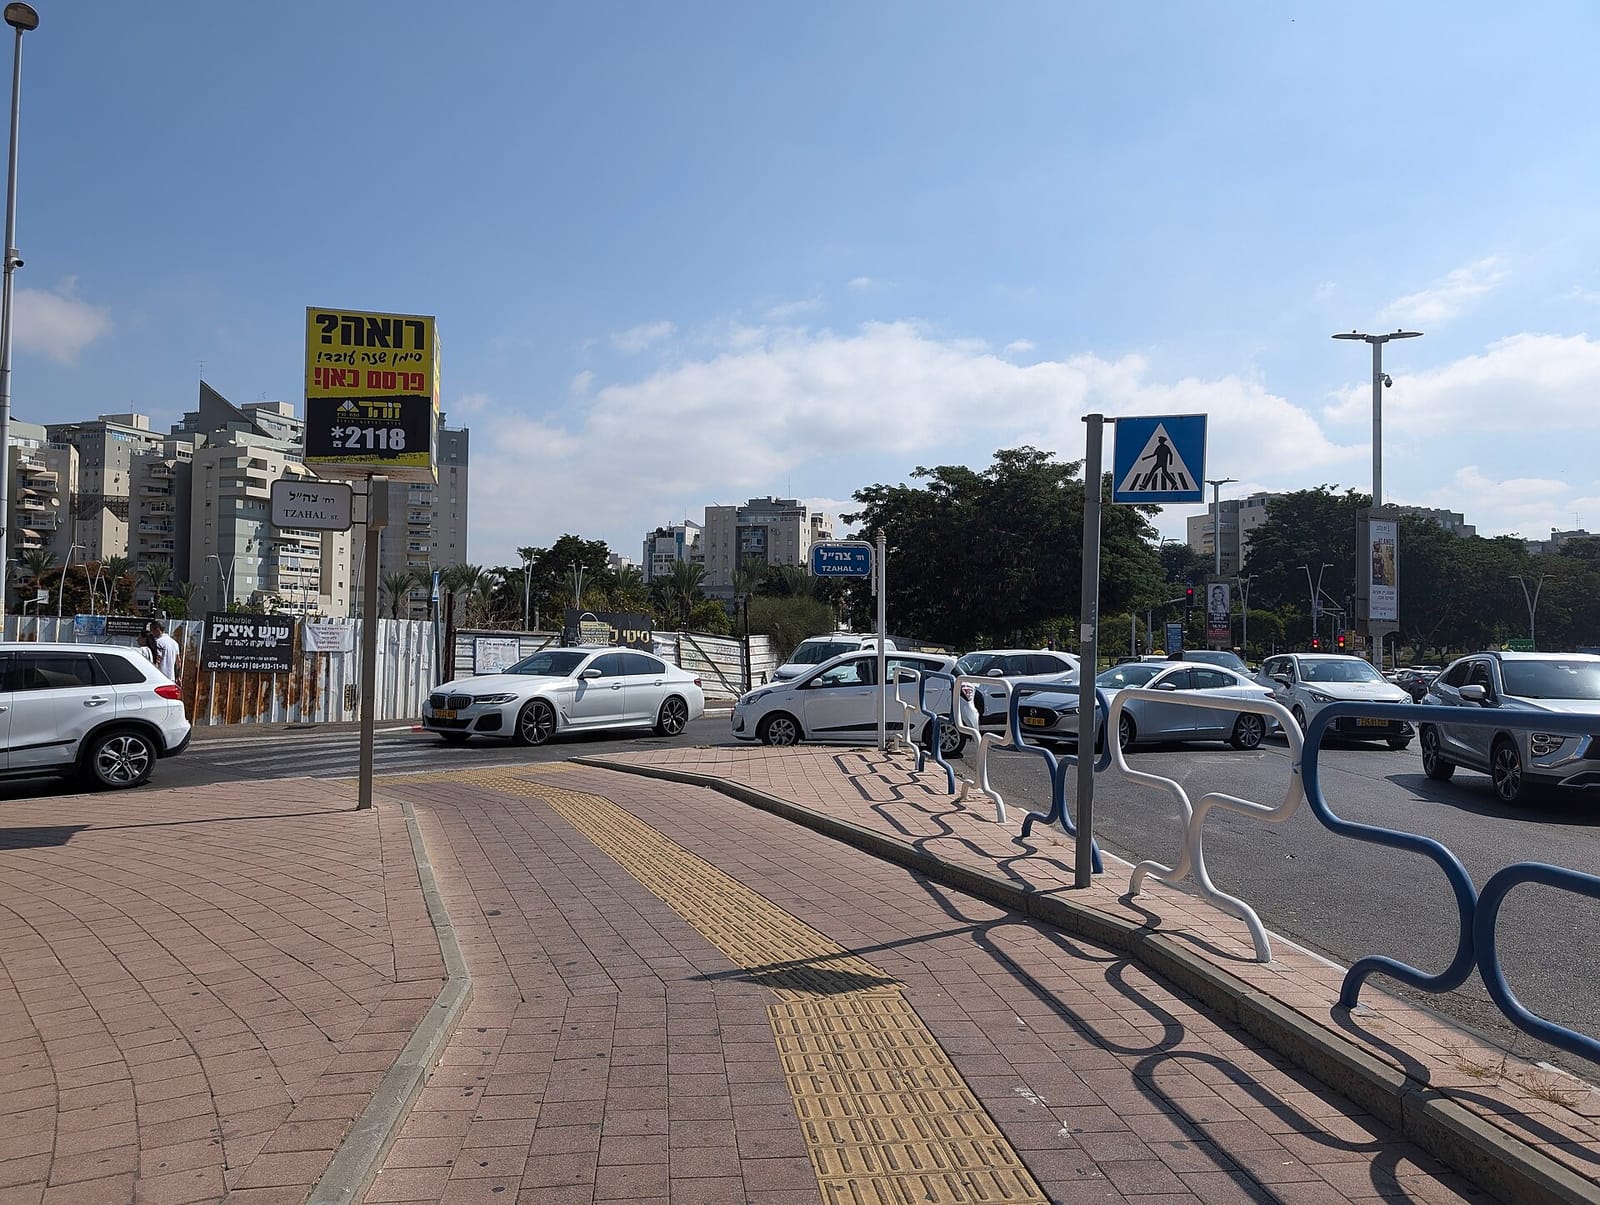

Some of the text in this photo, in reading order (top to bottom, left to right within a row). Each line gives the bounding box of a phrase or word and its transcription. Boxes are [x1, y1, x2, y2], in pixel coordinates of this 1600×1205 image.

[316, 314, 425, 350] רואה?
[316, 351, 422, 367] סימן שזה עובד!
[314, 367, 425, 391] פרסם כאן!
[283, 509, 327, 520] TZAHAL
[258, 626, 289, 639] שיש
[622, 629, 650, 644] סיטי
